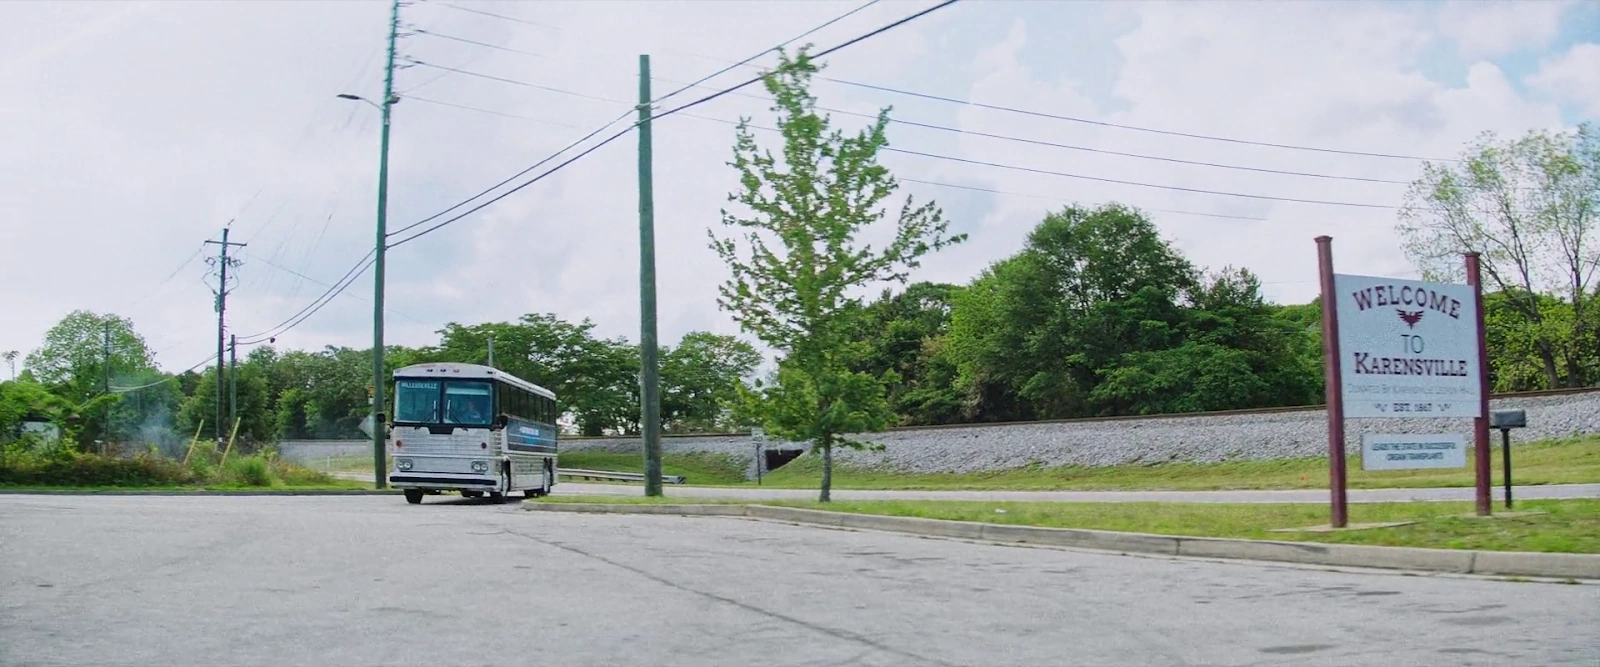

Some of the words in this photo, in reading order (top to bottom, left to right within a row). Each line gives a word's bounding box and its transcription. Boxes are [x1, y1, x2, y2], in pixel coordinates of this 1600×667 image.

[1352, 285, 1461, 320] WELCOME
[1400, 334, 1425, 354] TO
[1354, 352, 1468, 377] KARENSVILLE
